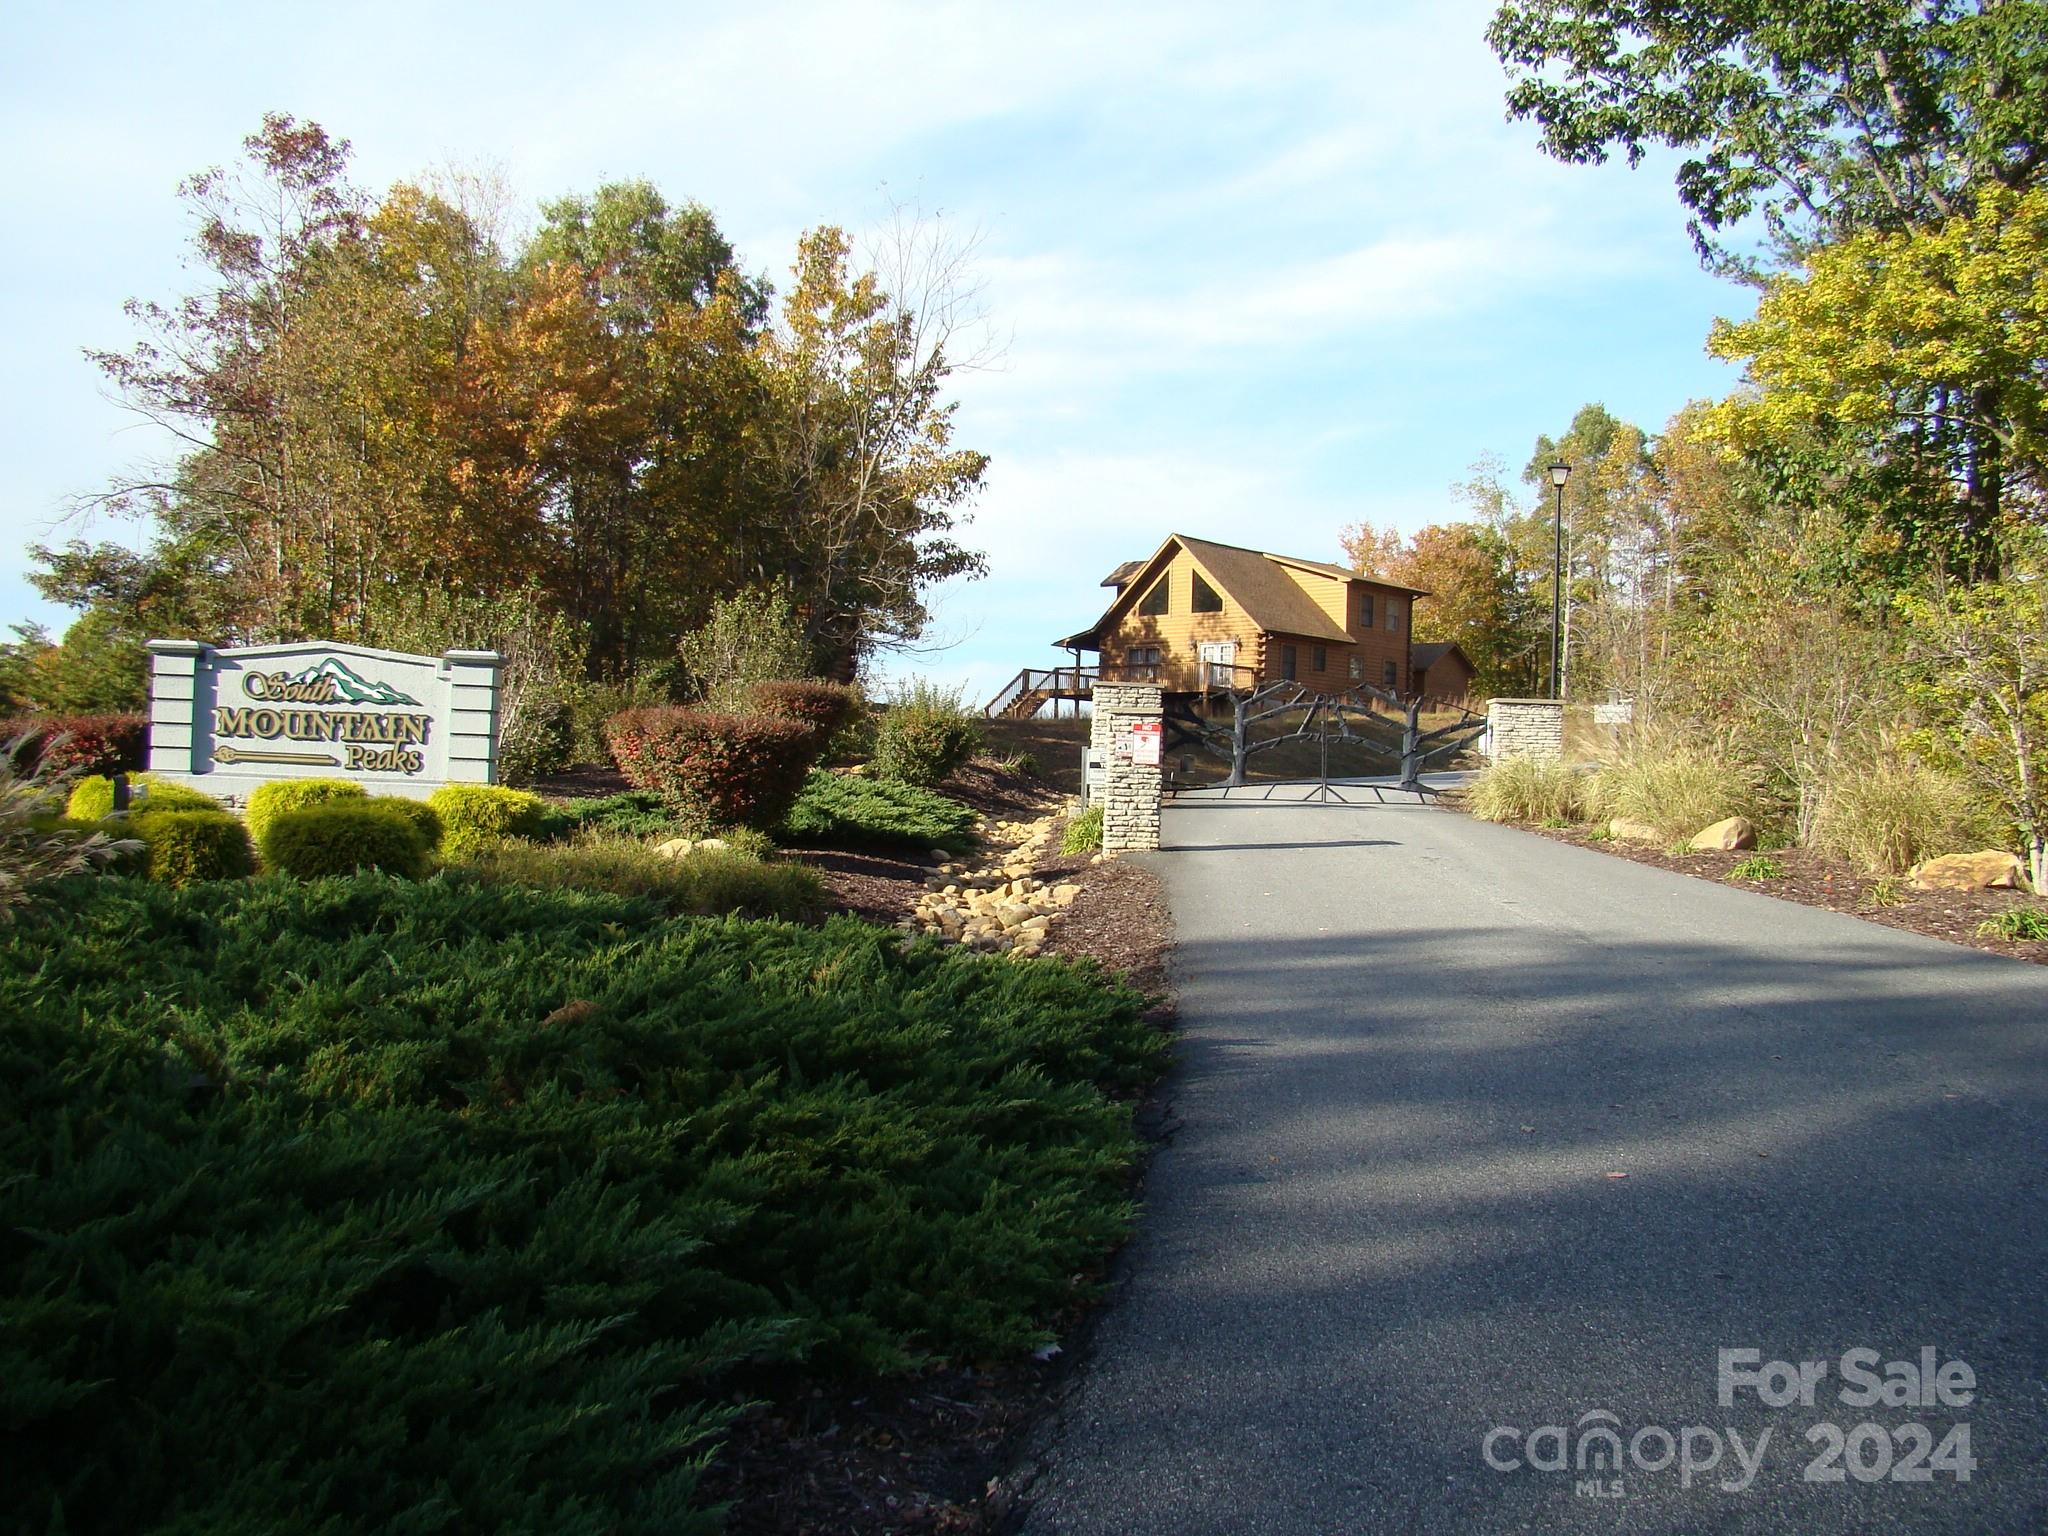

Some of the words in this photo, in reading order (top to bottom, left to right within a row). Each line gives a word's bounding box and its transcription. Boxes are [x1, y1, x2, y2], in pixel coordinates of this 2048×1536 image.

[242, 670, 336, 702] South
[216, 706, 433, 745] MOUNTAIN
[344, 738, 422, 774] Peaks
